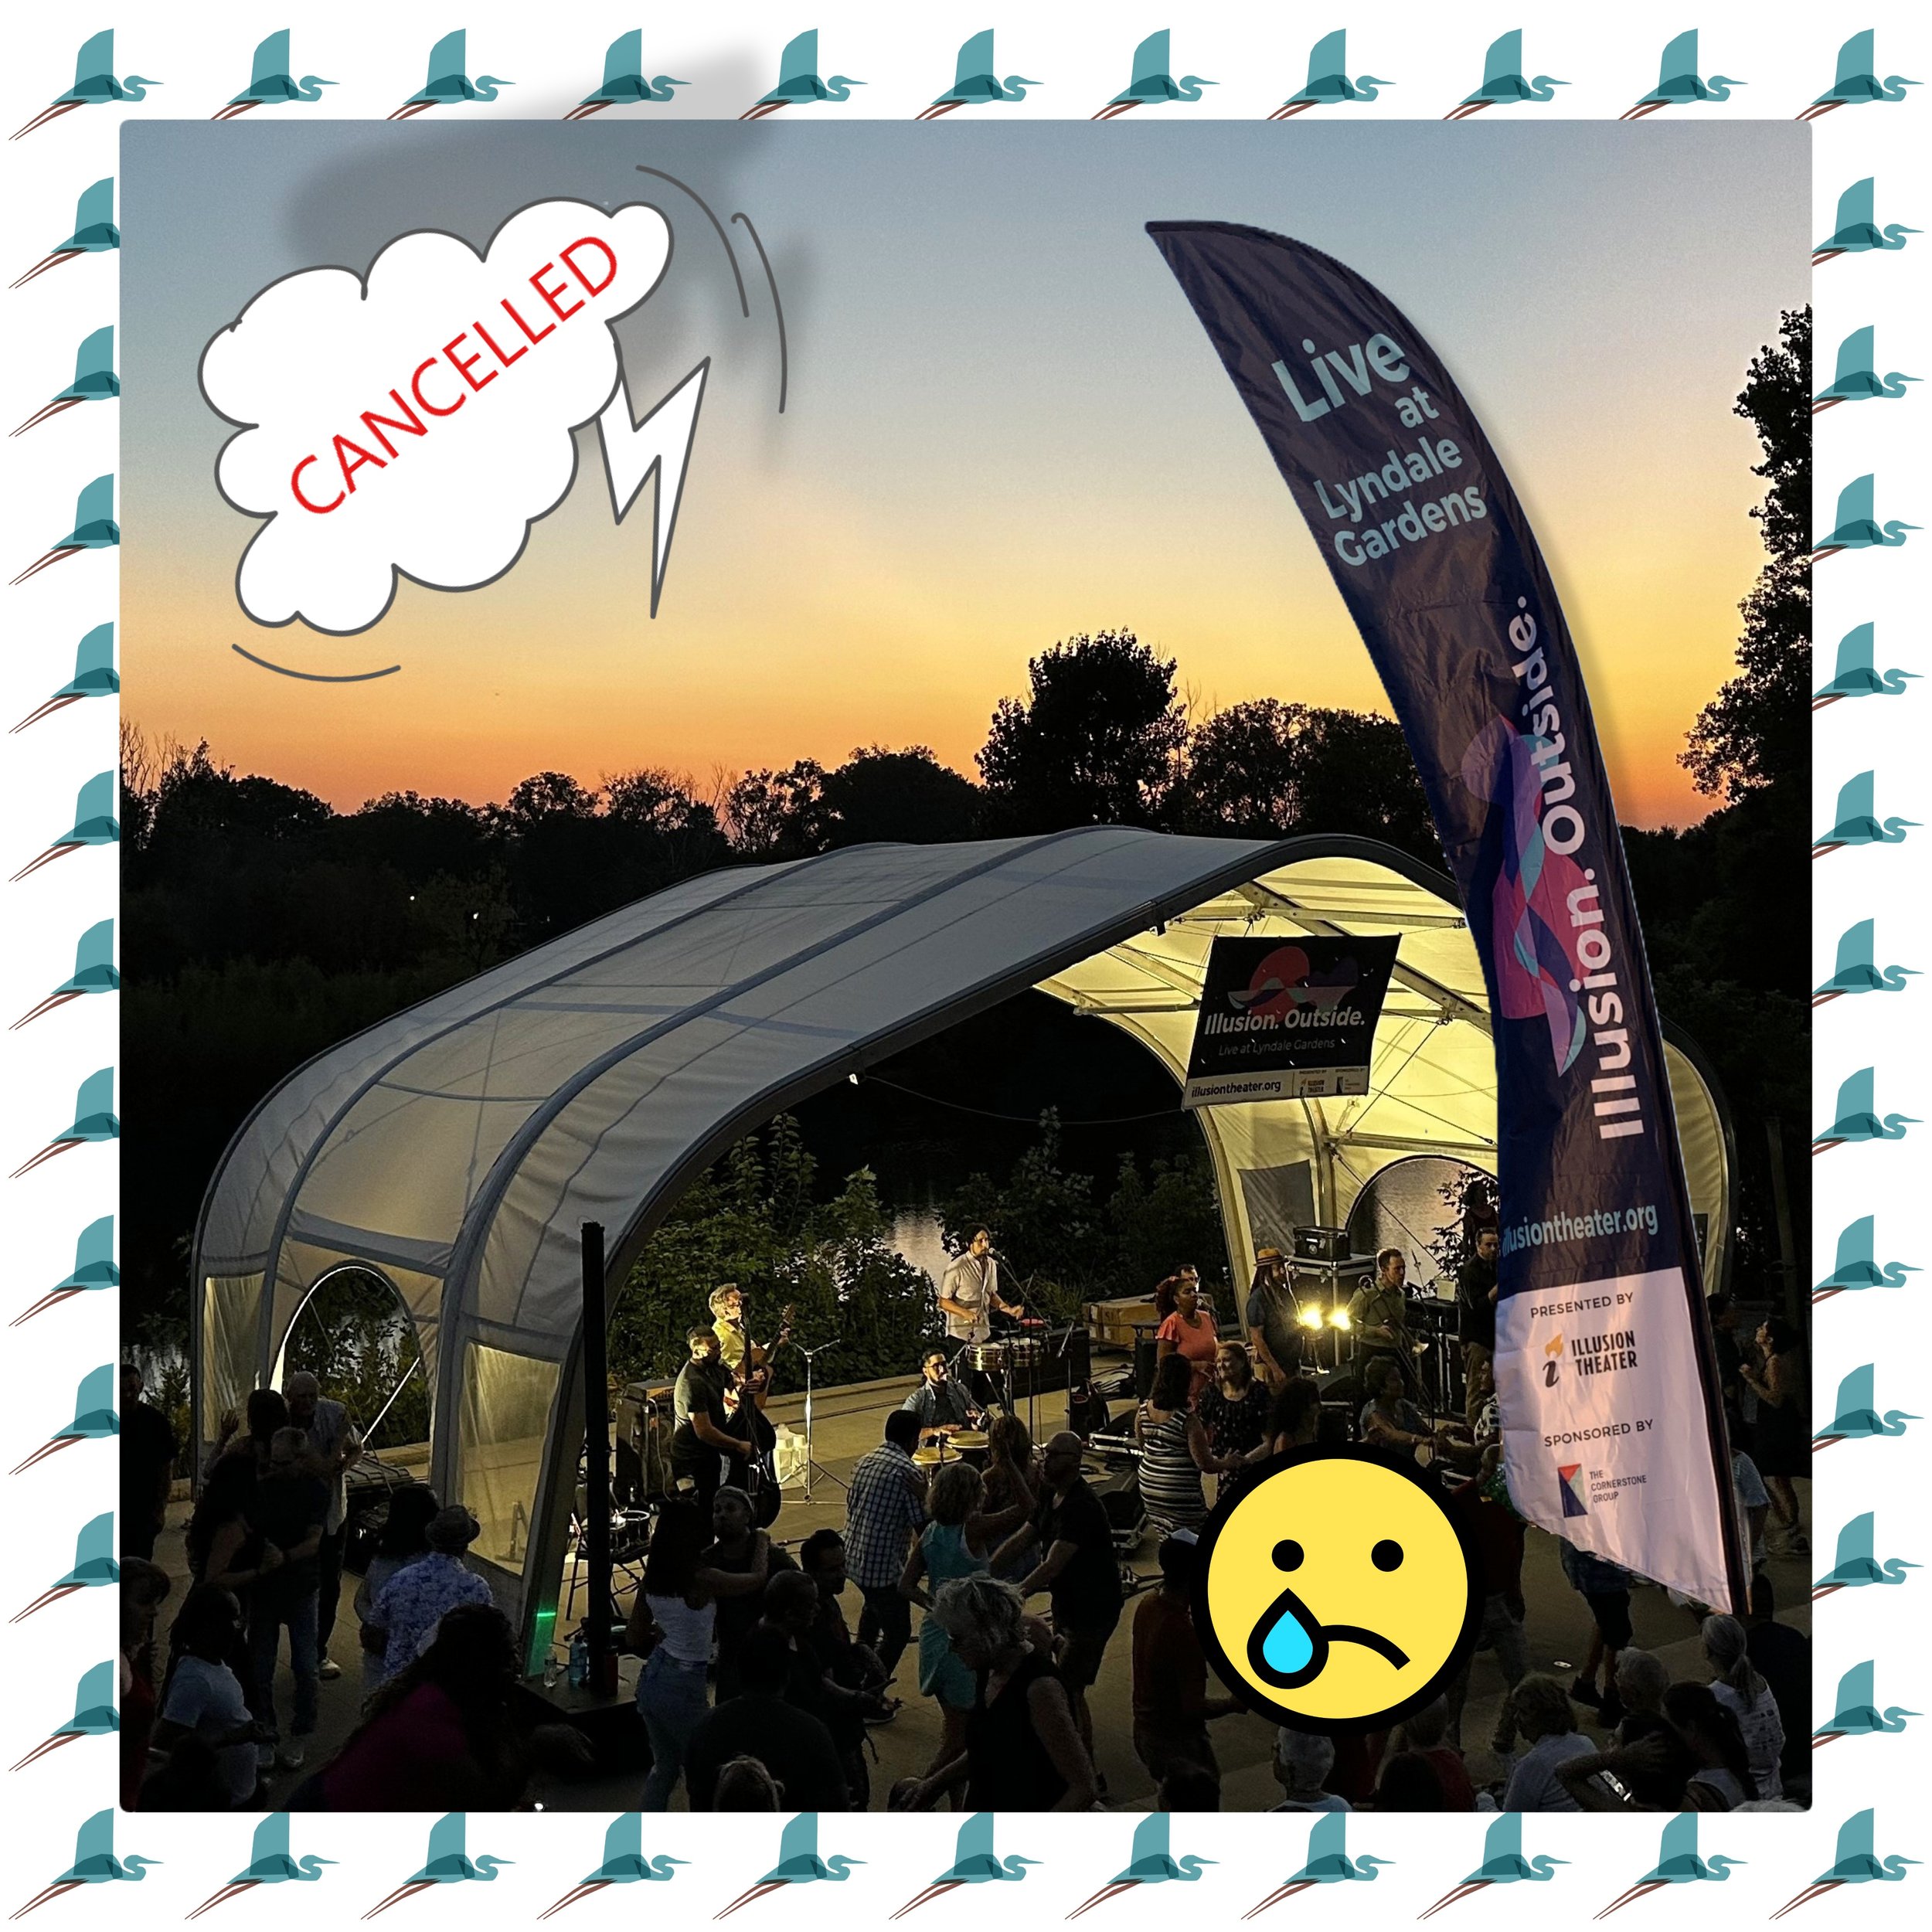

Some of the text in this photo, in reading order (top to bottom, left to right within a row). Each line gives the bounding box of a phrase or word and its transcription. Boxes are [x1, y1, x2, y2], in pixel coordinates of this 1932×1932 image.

[1271, 332, 1410, 422] Live
[1393, 386, 1439, 428] at
[1314, 436, 1463, 524] Lyndale
[1334, 485, 1487, 566] Gardens
[1508, 596, 1645, 1140] Illusion. Outside.
[1205, 1006, 1366, 1035] Illusion. Outside.
[1218, 1043, 1238, 1056] Live
[1240, 1044, 1251, 1054] at
[1294, 1039, 1335, 1051] Gardens
[1191, 1080, 1281, 1098] illusiontheater.org
[1530, 1291, 1634, 1318] PRESENTED BY
[1571, 1330, 1635, 1357] ILLUSION
[1574, 1350, 1638, 1377] THEATER
[1544, 1419, 1653, 1447] SPONSORED BY
[1589, 1470, 1604, 1479] THE
[1590, 1475, 1647, 1492] CORNERSTONE
[1593, 1492, 1619, 1504] GROUP
